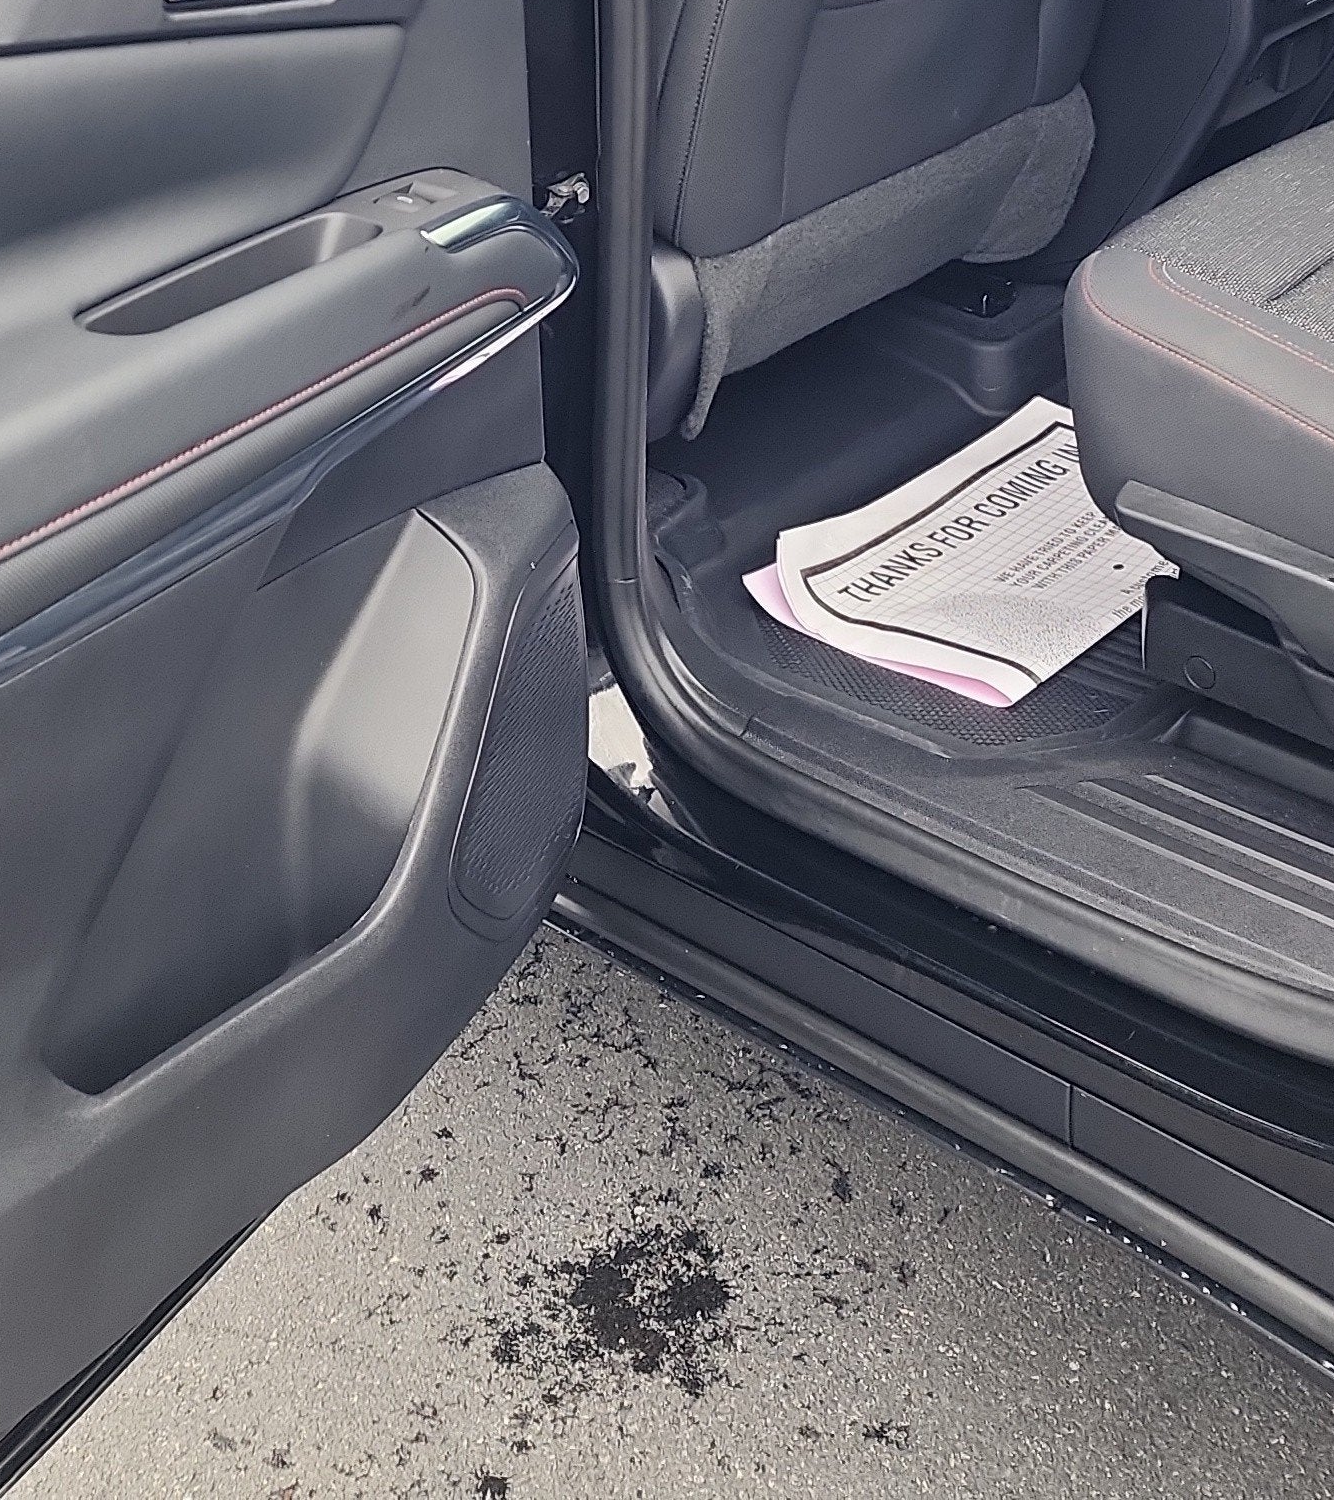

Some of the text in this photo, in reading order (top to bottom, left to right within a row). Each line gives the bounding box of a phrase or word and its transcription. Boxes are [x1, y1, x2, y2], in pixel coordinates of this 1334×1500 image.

[837, 542, 943, 602] THANKS
[926, 515, 990, 549] FOR
[973, 458, 1071, 519] COMING
[994, 511, 1096, 583] WE HAVE TRIED TO KEEP
[1009, 516, 1108, 587] YOUR CARPETING CLEA
[1031, 571, 1062, 589] WITH
[1057, 557, 1083, 574] THIS
[1077, 535, 1111, 560] PAPER
[1111, 605, 1133, 620] the
